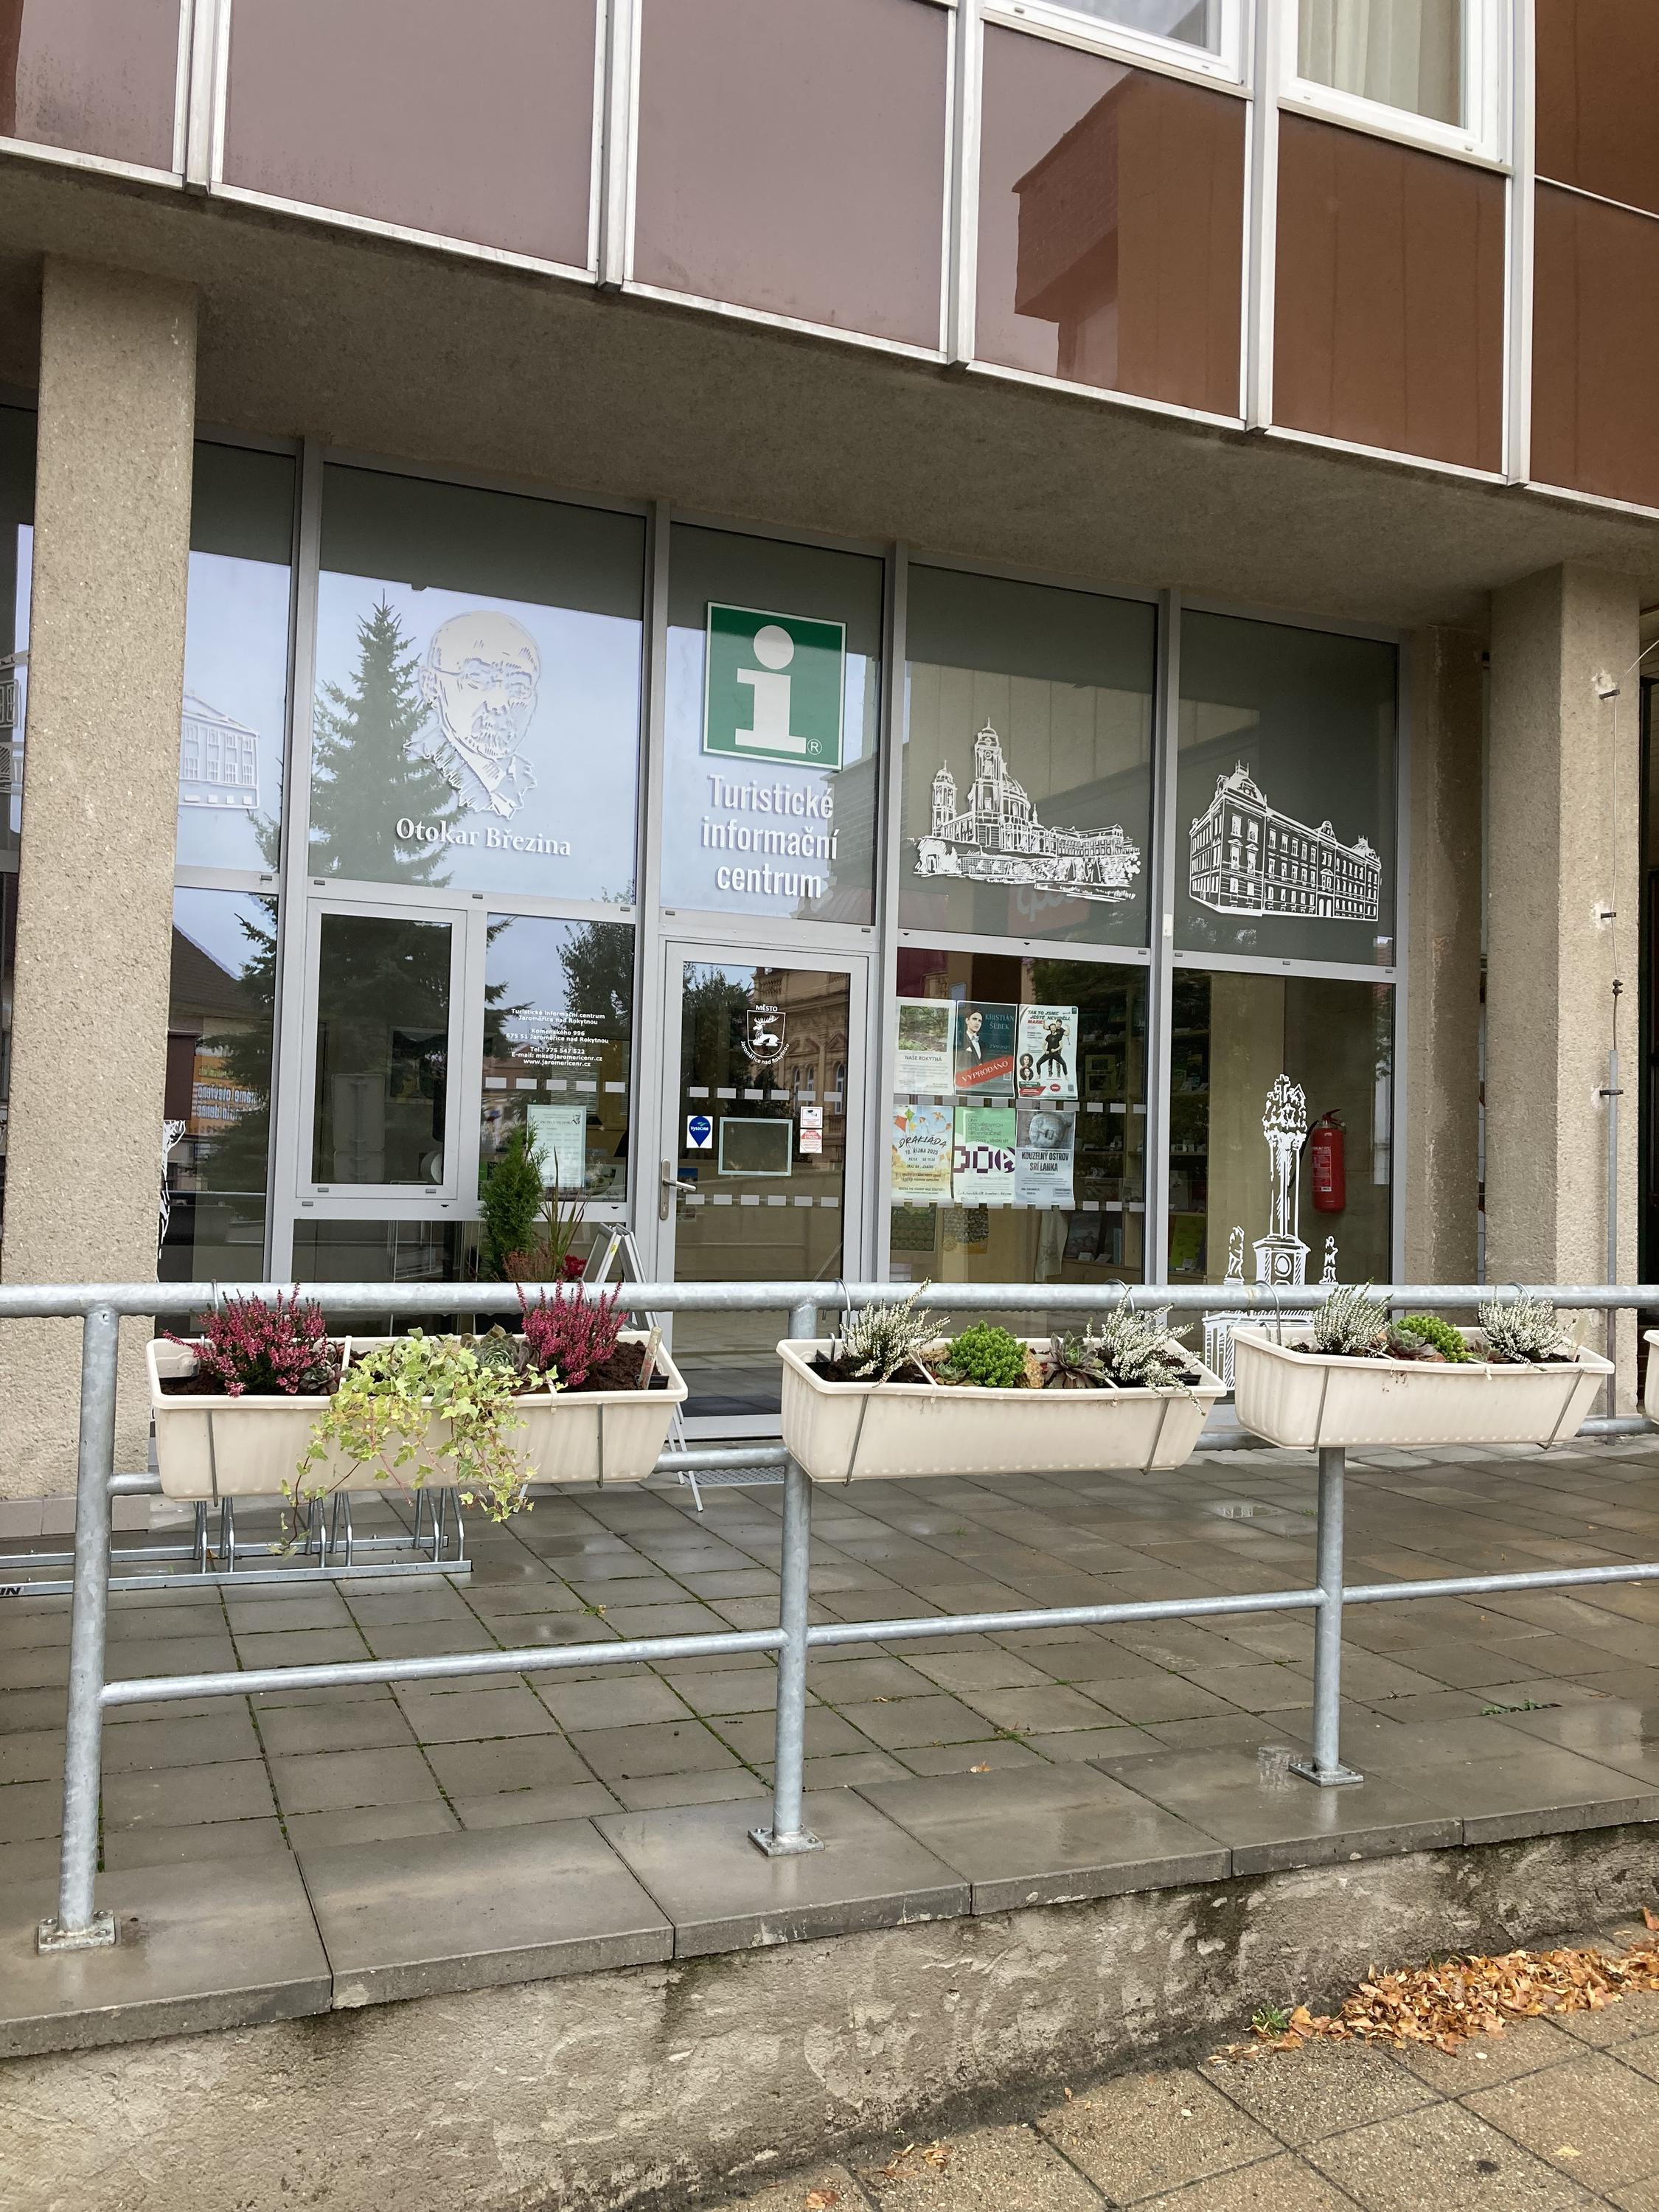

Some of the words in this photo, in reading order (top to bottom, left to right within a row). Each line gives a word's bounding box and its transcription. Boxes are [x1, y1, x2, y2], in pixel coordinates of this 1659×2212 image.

[709, 774, 833, 819] Turistické
[396, 818, 479, 846] Otokar
[486, 827, 571, 857] Březina
[701, 815, 838, 859] informační
[717, 863, 821, 898] centrum
[511, 1008, 542, 1016] Turistické
[985, 1013, 1015, 1021] KRISTIÁN
[569, 1018, 598, 1026] Rokytnou
[990, 1021, 1009, 1030] ŠEBEK
[740, 1040, 761, 1064] Jaroměřice
[771, 1043, 790, 1064] Rokytnou
[524, 1059, 591, 1067] www.jaromericenr.cz
[962, 1060, 1009, 1082] VYPRODÁNO
[898, 1135, 947, 1149] DRAKIÁDA
[1021, 1150, 1048, 1161] KOUZELNÝ
[1049, 1152, 1069, 1161] OSTROV
[1030, 1161, 1039, 1171] SRÍ
[1040, 1163, 1058, 1172] LANKA
